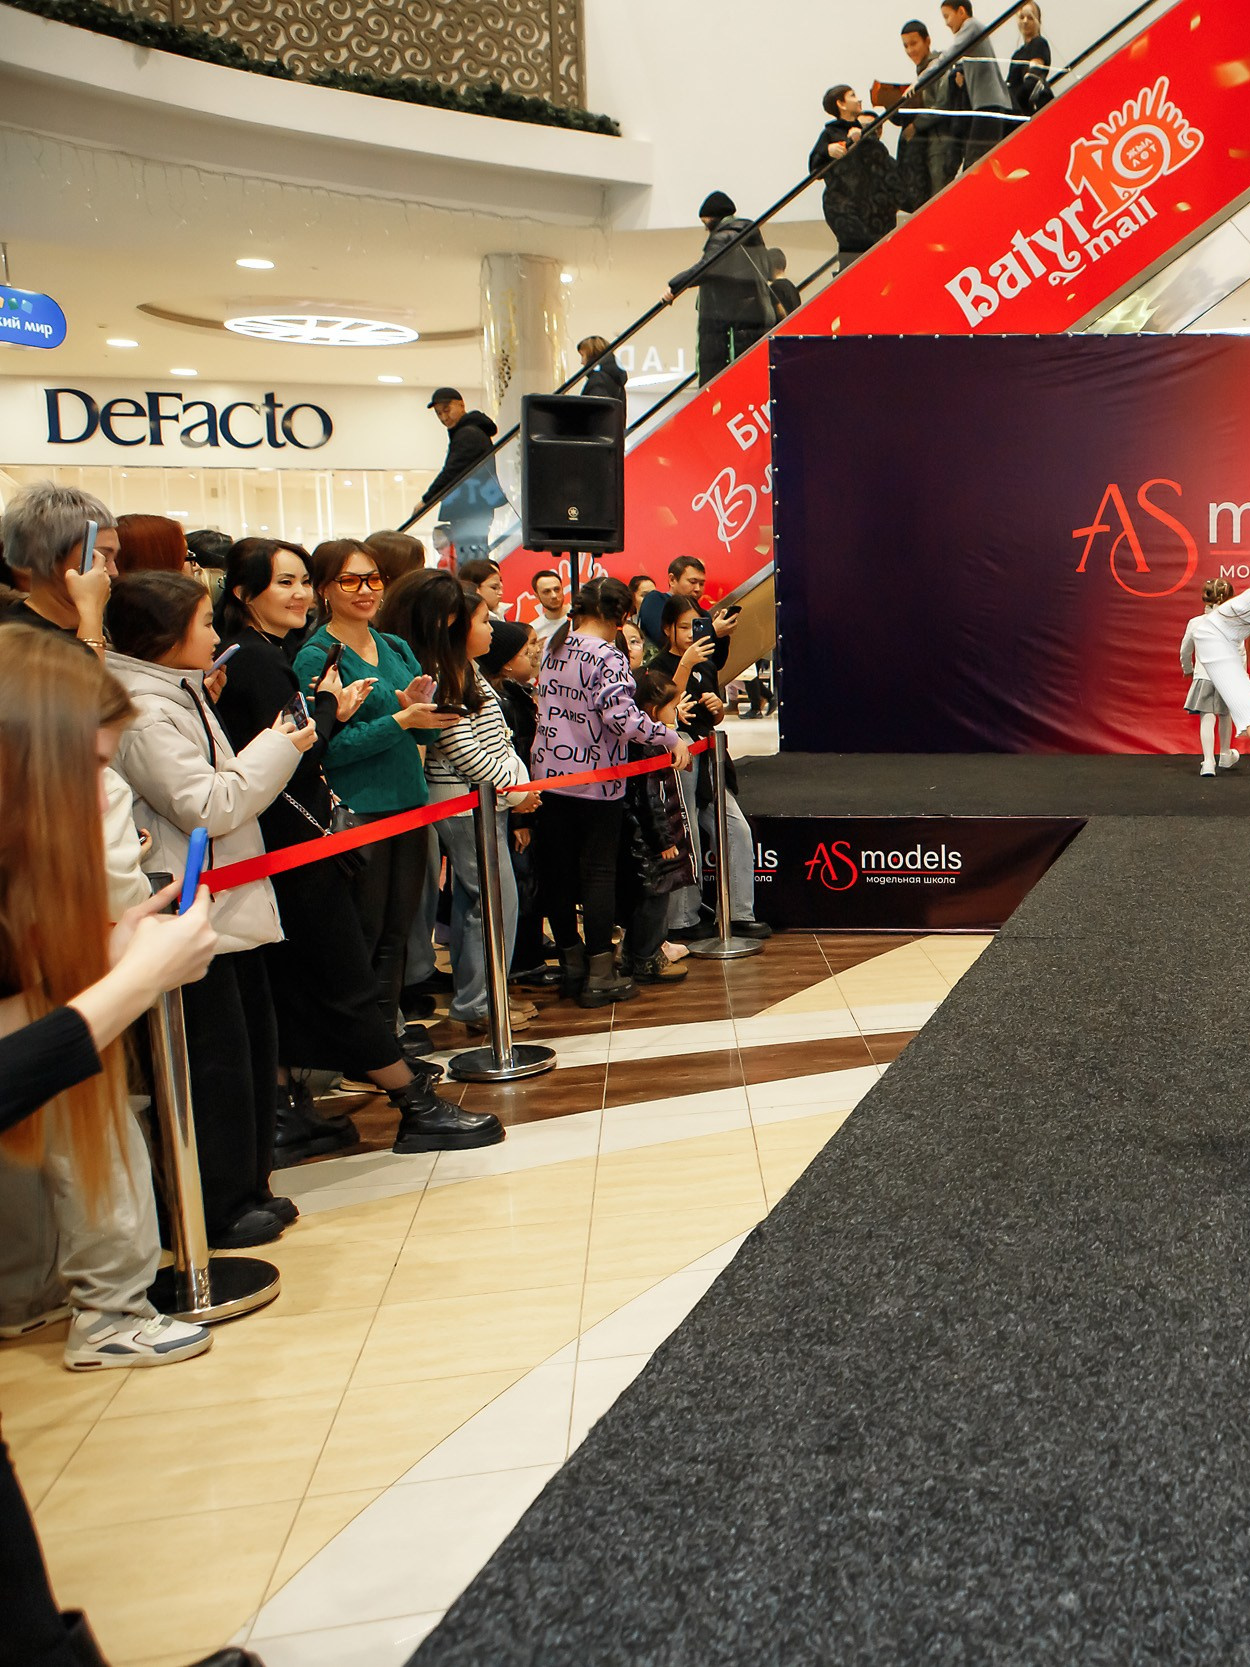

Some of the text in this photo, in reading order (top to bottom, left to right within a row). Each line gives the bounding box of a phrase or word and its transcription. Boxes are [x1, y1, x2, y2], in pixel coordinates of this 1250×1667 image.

[1084, 196, 1158, 263] mall
[945, 198, 1090, 328] Batyr
[24, 321, 53, 338] мир
[44, 388, 333, 449] DeFacto
[1072, 478, 1198, 598] AS
[548, 706, 587, 724] PARIS
[546, 737, 601, 765] LOUIS
[804, 840, 963, 891] AS models
[923, 876, 956, 884] школа
